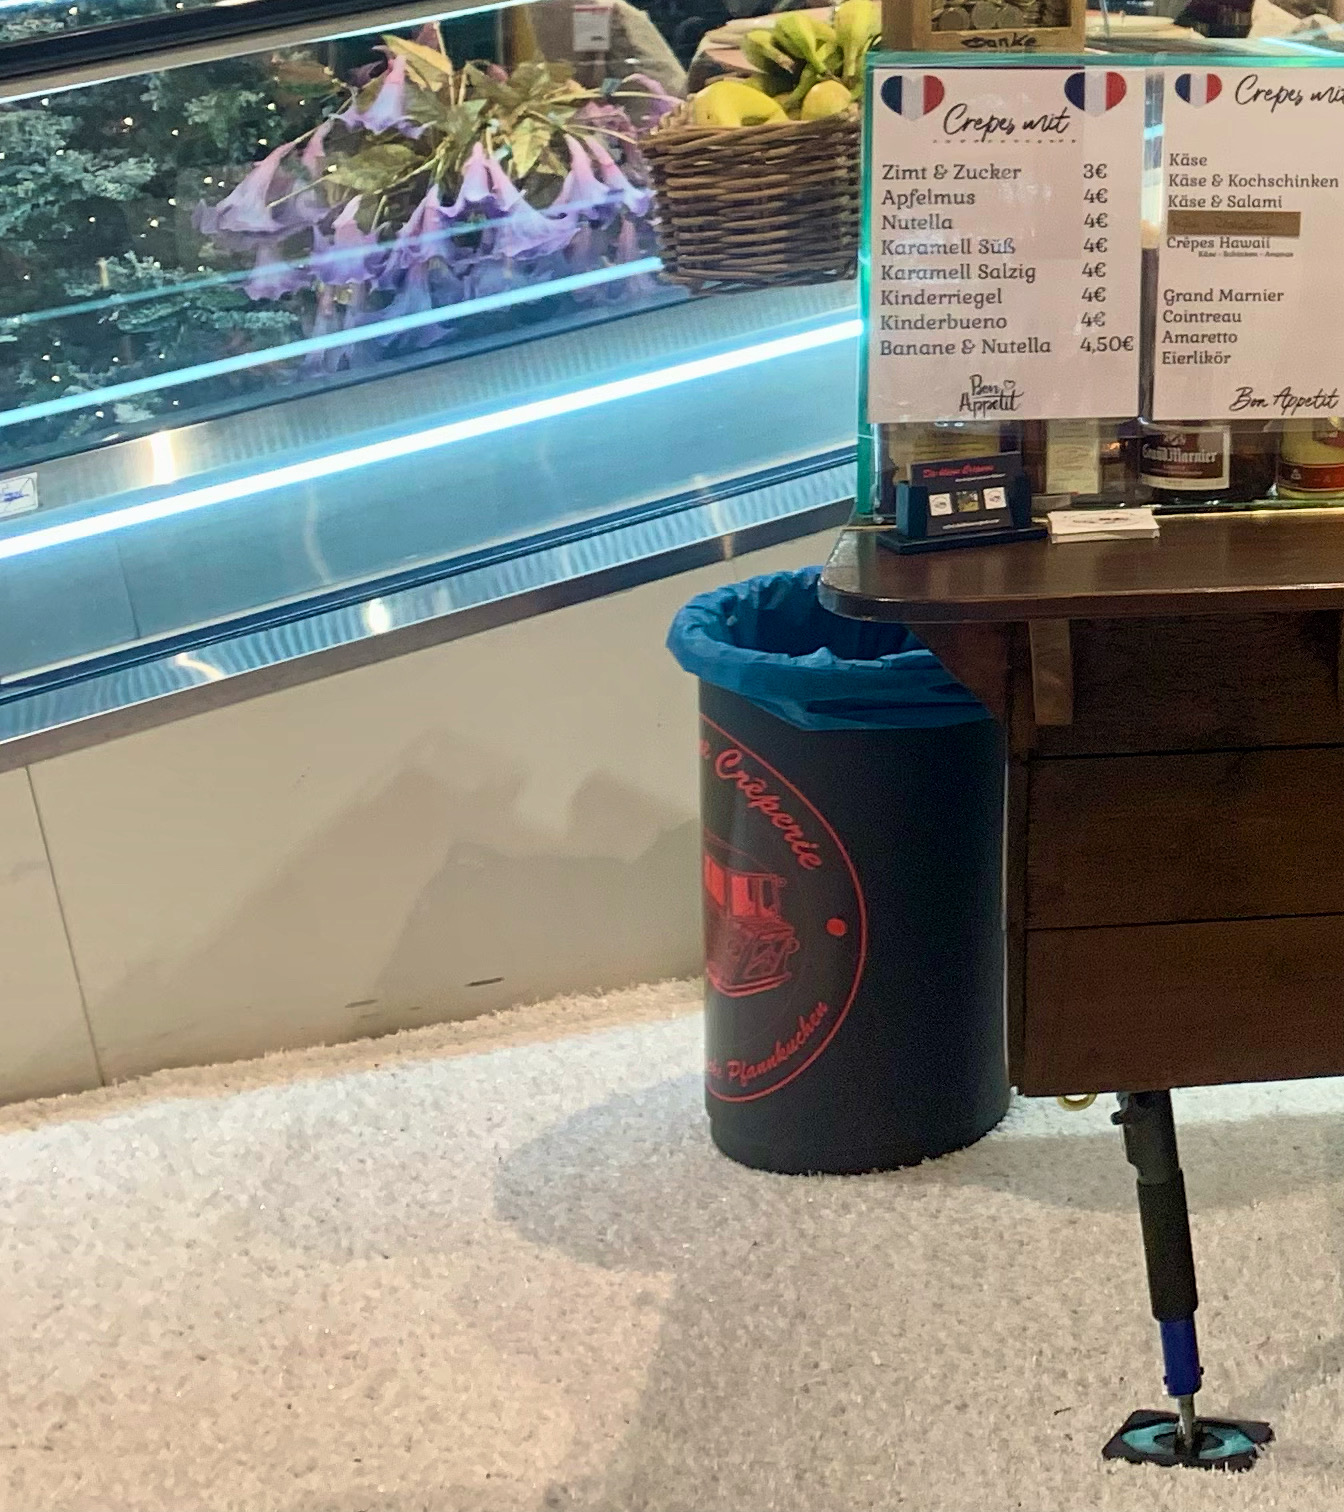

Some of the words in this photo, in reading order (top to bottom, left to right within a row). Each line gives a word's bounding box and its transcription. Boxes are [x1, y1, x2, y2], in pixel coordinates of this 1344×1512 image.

[1235, 74, 1303, 113] Crepes
[943, 104, 1015, 141] Crepes
[1022, 107, 1073, 134] mit
[1169, 153, 1208, 166] Käse
[882, 164, 926, 180] Zimt
[934, 164, 948, 179] &
[953, 164, 1021, 180] Zucker
[1083, 164, 1107, 179] 3€
[1169, 174, 1206, 187] Käse
[1212, 174, 1223, 187] &
[1228, 174, 1339, 188] Kochschinken
[881, 189, 976, 209] Apfelmus
[1084, 189, 1107, 204] 4€
[1168, 195, 1206, 208] Käse
[1211, 195, 1222, 208] &
[1227, 195, 1282, 208] Salami
[881, 214, 953, 230] Nutella
[1084, 213, 1108, 228] 4€
[881, 239, 971, 255] Karamell
[979, 238, 1015, 254] Süß
[1084, 238, 1107, 253] 4€
[881, 264, 971, 280] Karamell
[978, 264, 1036, 283] Salzig
[1082, 262, 1106, 277] 4€
[880, 288, 1002, 309] Kinderriegel
[1081, 287, 1106, 302] 4€
[1164, 289, 1213, 306] Grand
[1219, 290, 1284, 302] Marnier
[880, 314, 1007, 330] Kinderbueno
[1081, 312, 1105, 327] 4€
[1163, 310, 1241, 323] Cointreau
[880, 340, 955, 355] Banane
[961, 339, 976, 355] &
[981, 338, 1052, 354] Nutella
[1080, 335, 1134, 354] 4,50€
[1162, 330, 1237, 344] Amaretto
[1162, 351, 1231, 364] Eierlikör
[1229, 387, 1268, 411] Bon
[1273, 387, 1339, 415] Appetit
